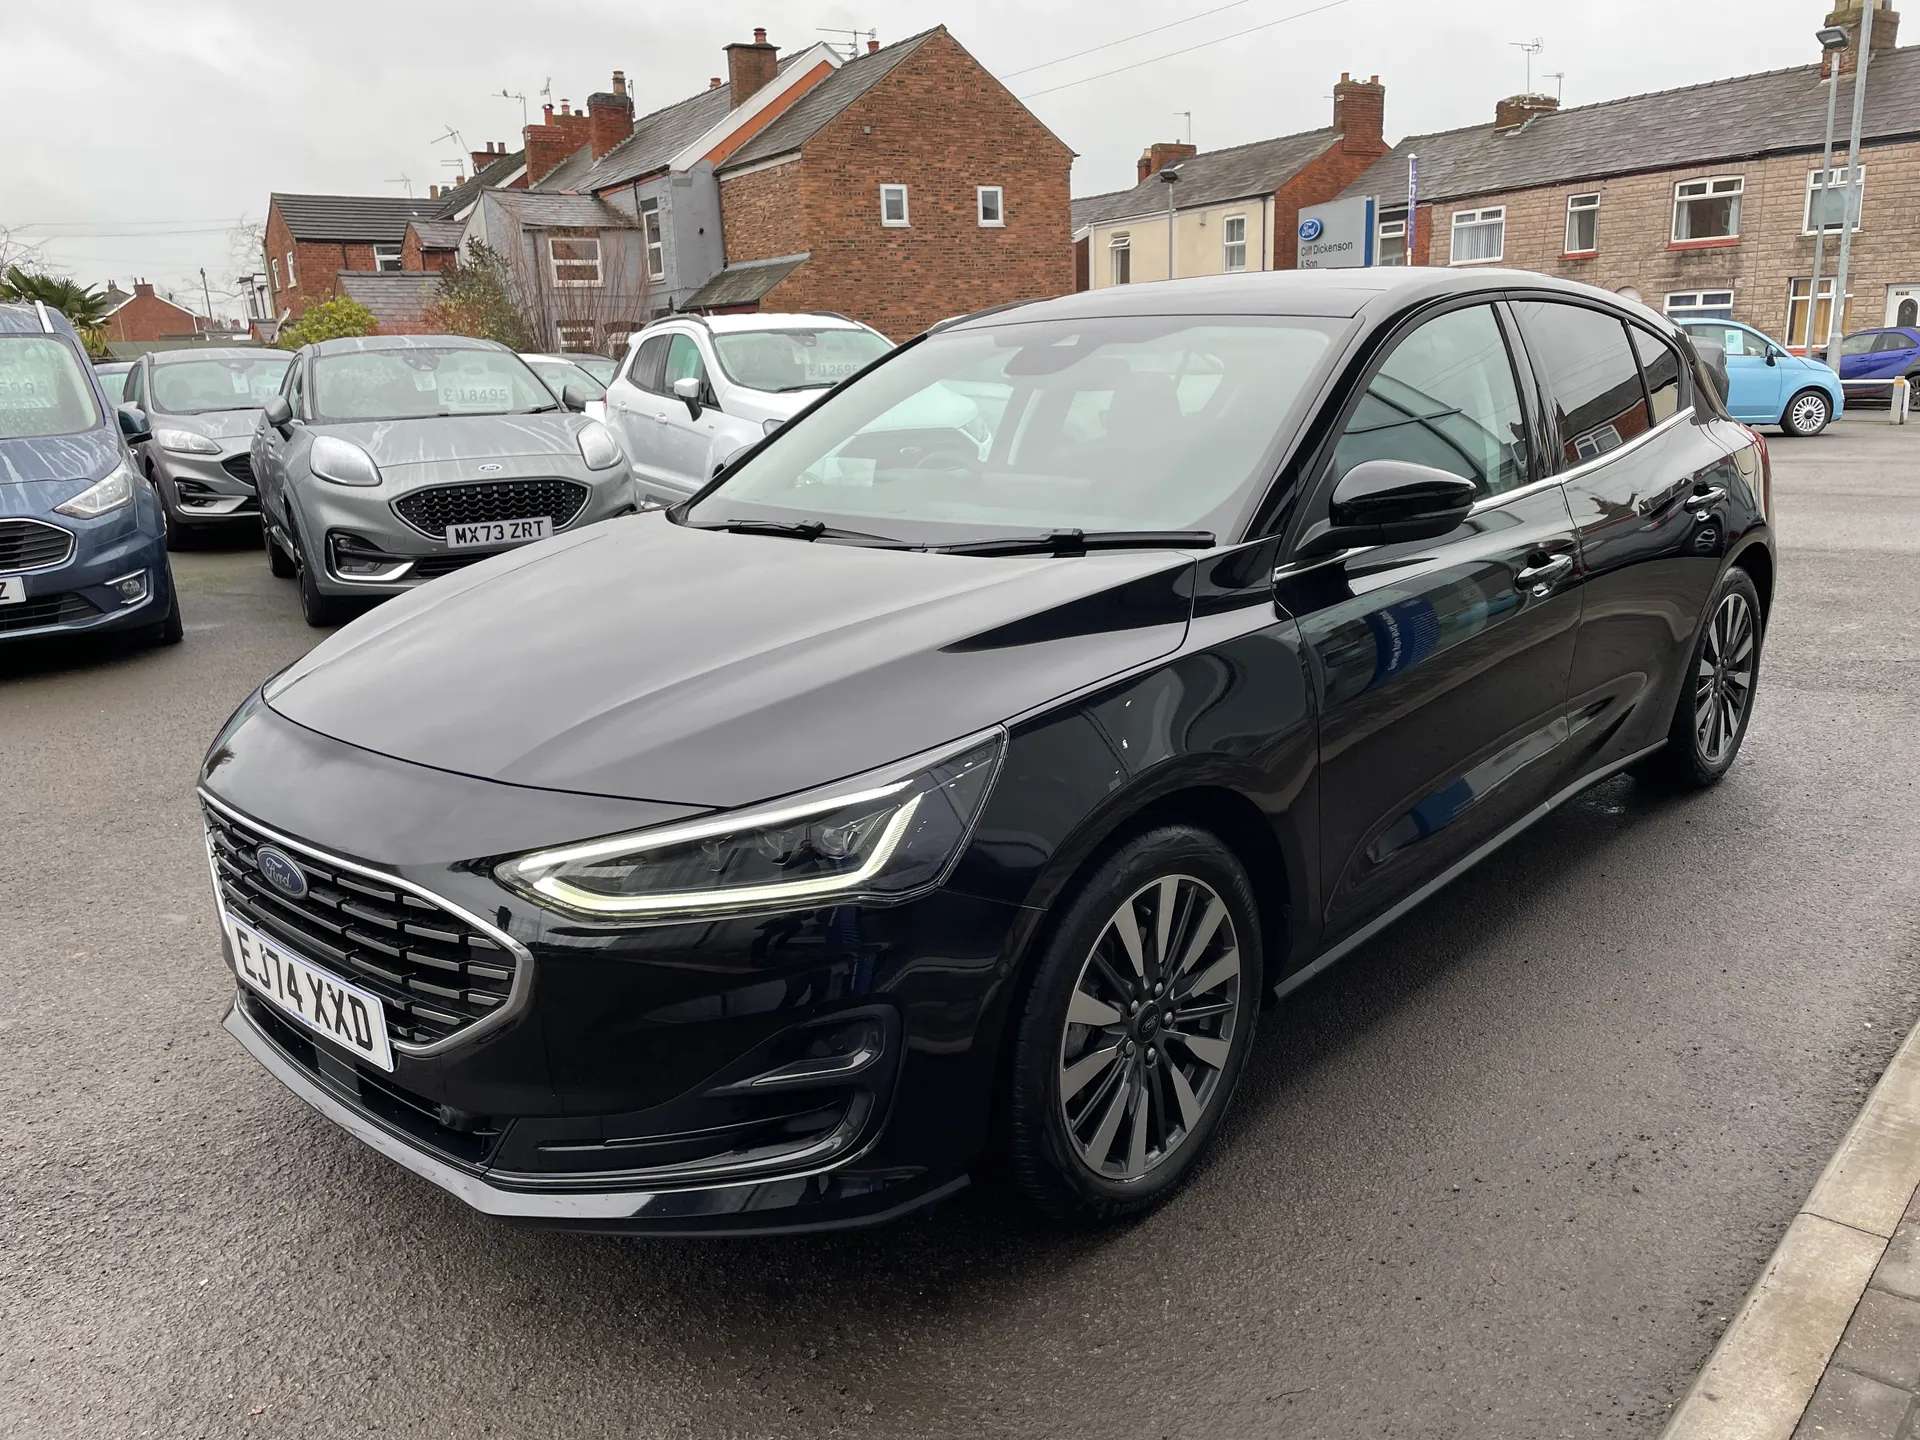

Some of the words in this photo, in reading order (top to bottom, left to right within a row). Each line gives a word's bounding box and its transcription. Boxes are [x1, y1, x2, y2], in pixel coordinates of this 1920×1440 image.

[1313, 241, 1353, 255] Dickenson
[455, 525, 504, 544] MX73
[509, 520, 544, 539] ZRT
[264, 856, 292, 889] Ford
[236, 927, 303, 1013] EJ74
[306, 974, 374, 1051] XXD
